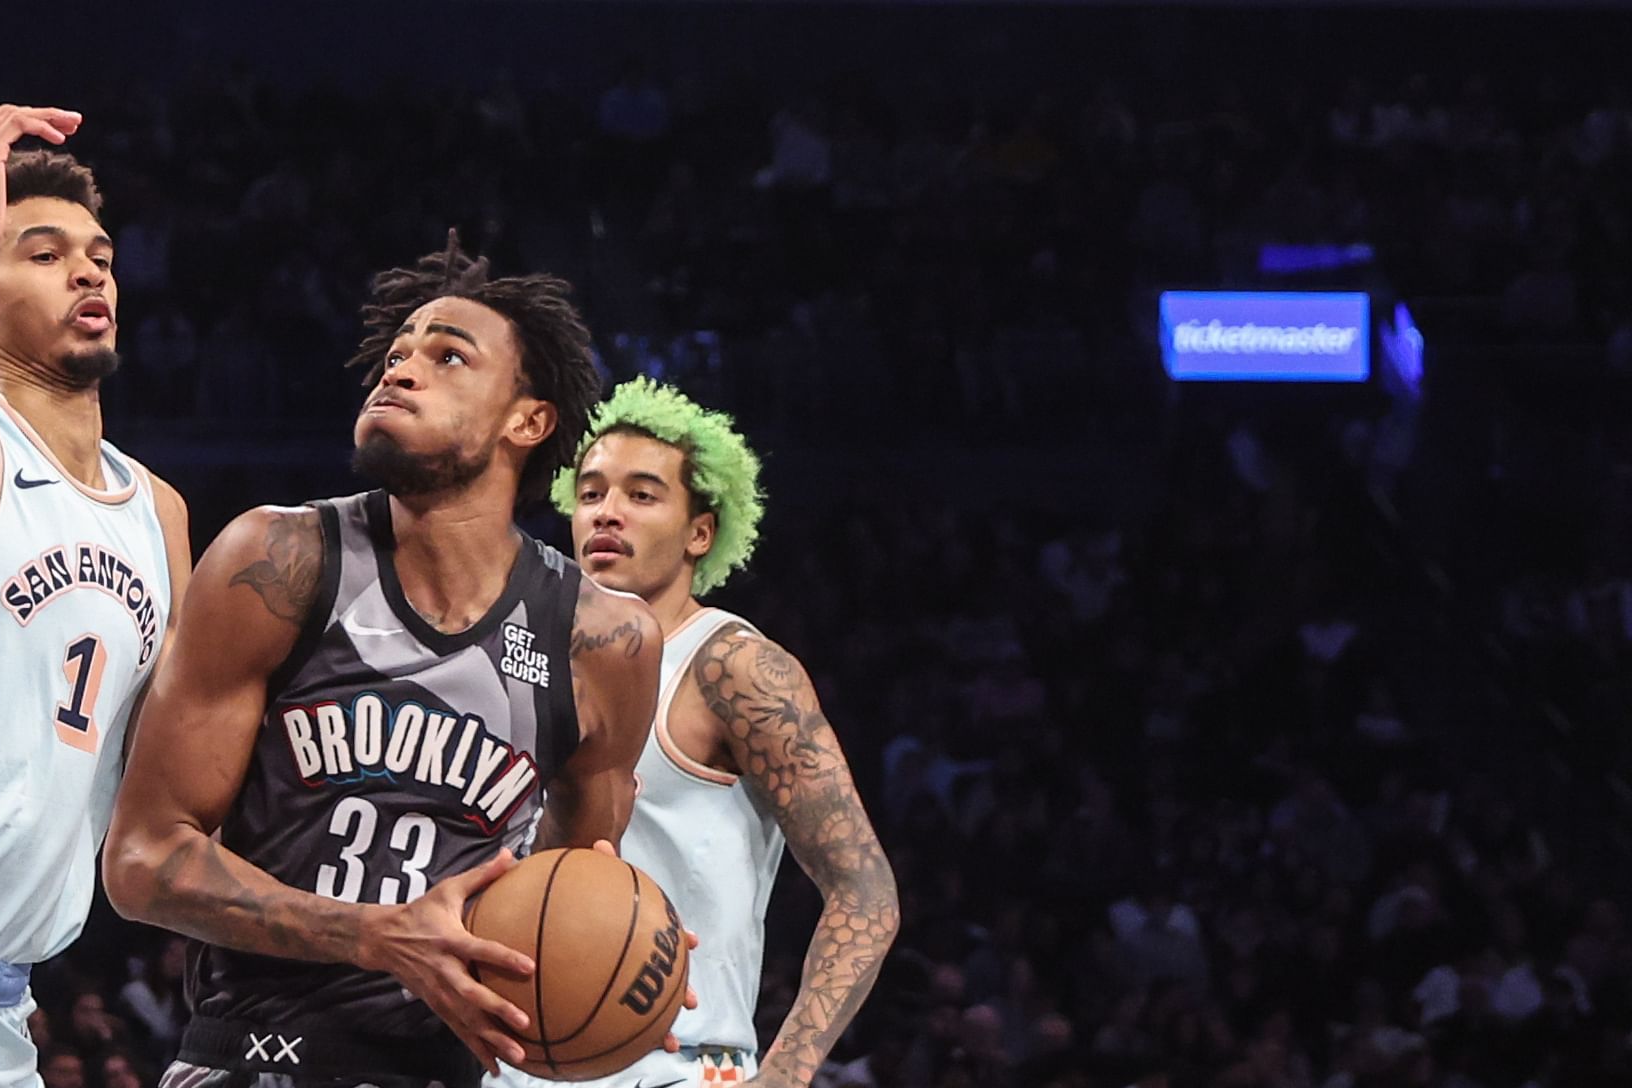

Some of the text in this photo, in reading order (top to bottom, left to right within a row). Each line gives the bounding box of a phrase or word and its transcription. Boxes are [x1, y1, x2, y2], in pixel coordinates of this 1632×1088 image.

[1174, 320, 1356, 354] ticketmaster
[3, 546, 157, 666] SAN ANTONIO
[504, 624, 535, 648] GET
[55, 635, 102, 742] 1
[500, 657, 550, 688] GUIDE
[503, 640, 549, 671] YOUR
[282, 694, 536, 822] BROOKLYN
[316, 796, 436, 904] 33
